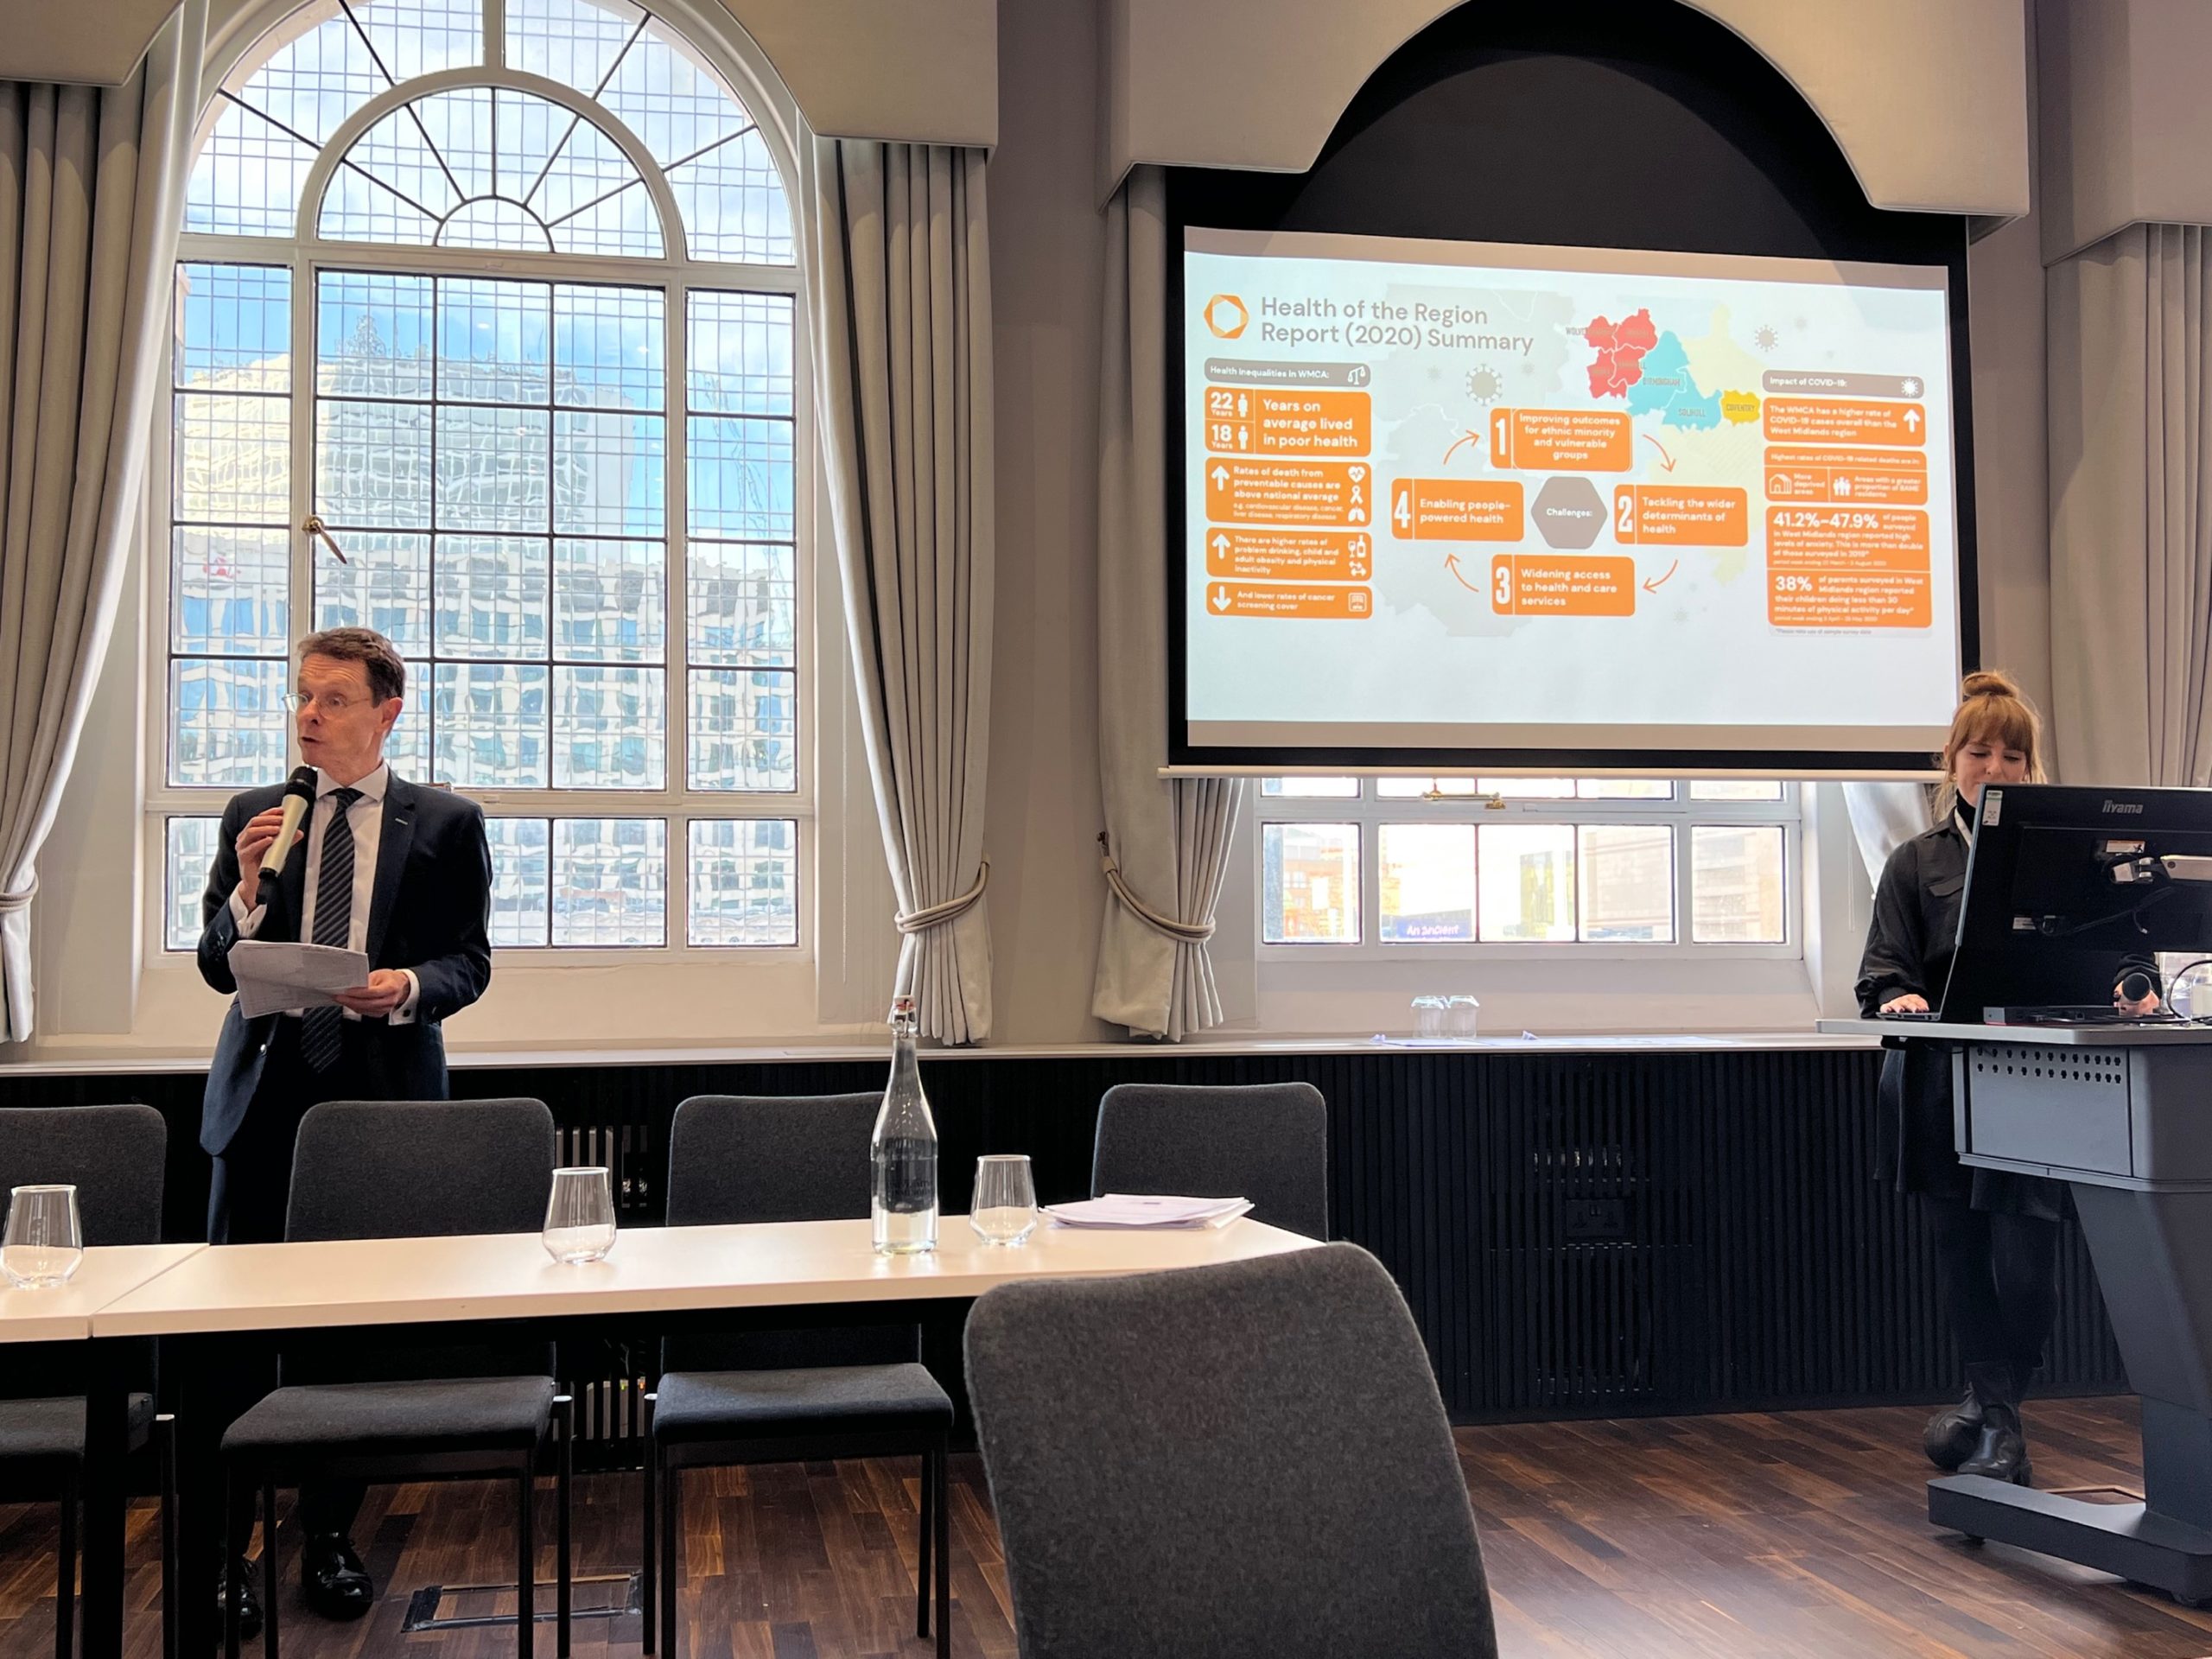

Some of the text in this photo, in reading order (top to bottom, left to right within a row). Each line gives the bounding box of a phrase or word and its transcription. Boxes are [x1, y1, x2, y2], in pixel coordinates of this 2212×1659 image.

[1261, 297, 1487, 327] Health of the Region
[1262, 321, 1533, 356] Report (2020) Summary
[1211, 365, 1236, 375] Health
[1298, 369, 1329, 378] WMCA:
[1770, 377, 1797, 386] Impact
[1211, 391, 1233, 410] 22
[1263, 399, 1320, 411] Years on
[1839, 408, 1864, 417] higher
[1263, 418, 1352, 431] average lived
[1520, 414, 1620, 425] Improving outcomes
[1770, 416, 1809, 424] COVID-19
[1865, 419, 1882, 428] than
[1211, 424, 1232, 442] 18
[1496, 418, 1505, 455] 1
[1541, 426, 1572, 435] ethnic
[1574, 428, 1615, 439] minority
[1793, 427, 1829, 435] Midlands
[1831, 429, 1856, 437] region
[1211, 441, 1232, 449] Years
[1263, 434, 1357, 448] in poor health
[1535, 438, 1606, 448] and vulnerable
[1553, 451, 1588, 461] groups
[1234, 466, 1258, 475] Rates
[1272, 467, 1299, 477] death
[1301, 467, 1323, 477] from
[1234, 480, 1288, 489] preventable
[1234, 490, 1338, 502] above national average
[1421, 499, 1465, 512] Enabling
[1643, 497, 1735, 509] Tackling the wider
[1395, 491, 1410, 529] 4
[1547, 508, 1592, 518] Challenges:
[1618, 495, 1633, 532] 2
[1421, 513, 1503, 524] powered health
[1643, 511, 1726, 521] determinants of
[1643, 524, 1676, 534] health
[1272, 537, 1296, 546] higher
[1895, 533, 1910, 542] high
[1256, 556, 1284, 565] obesity
[1235, 565, 1271, 575] inactivity
[1522, 569, 1611, 581] Widening access
[1496, 567, 1510, 604] 3
[1522, 583, 1532, 592] to
[1535, 582, 1568, 593] health
[1572, 584, 1591, 593] and
[1776, 576, 1812, 592] 38%
[1237, 590, 1252, 599] And
[1237, 601, 1274, 611] screening
[1522, 597, 1566, 606] services
[2102, 799, 2143, 814] iiyama
[1407, 925, 1420, 935] An
